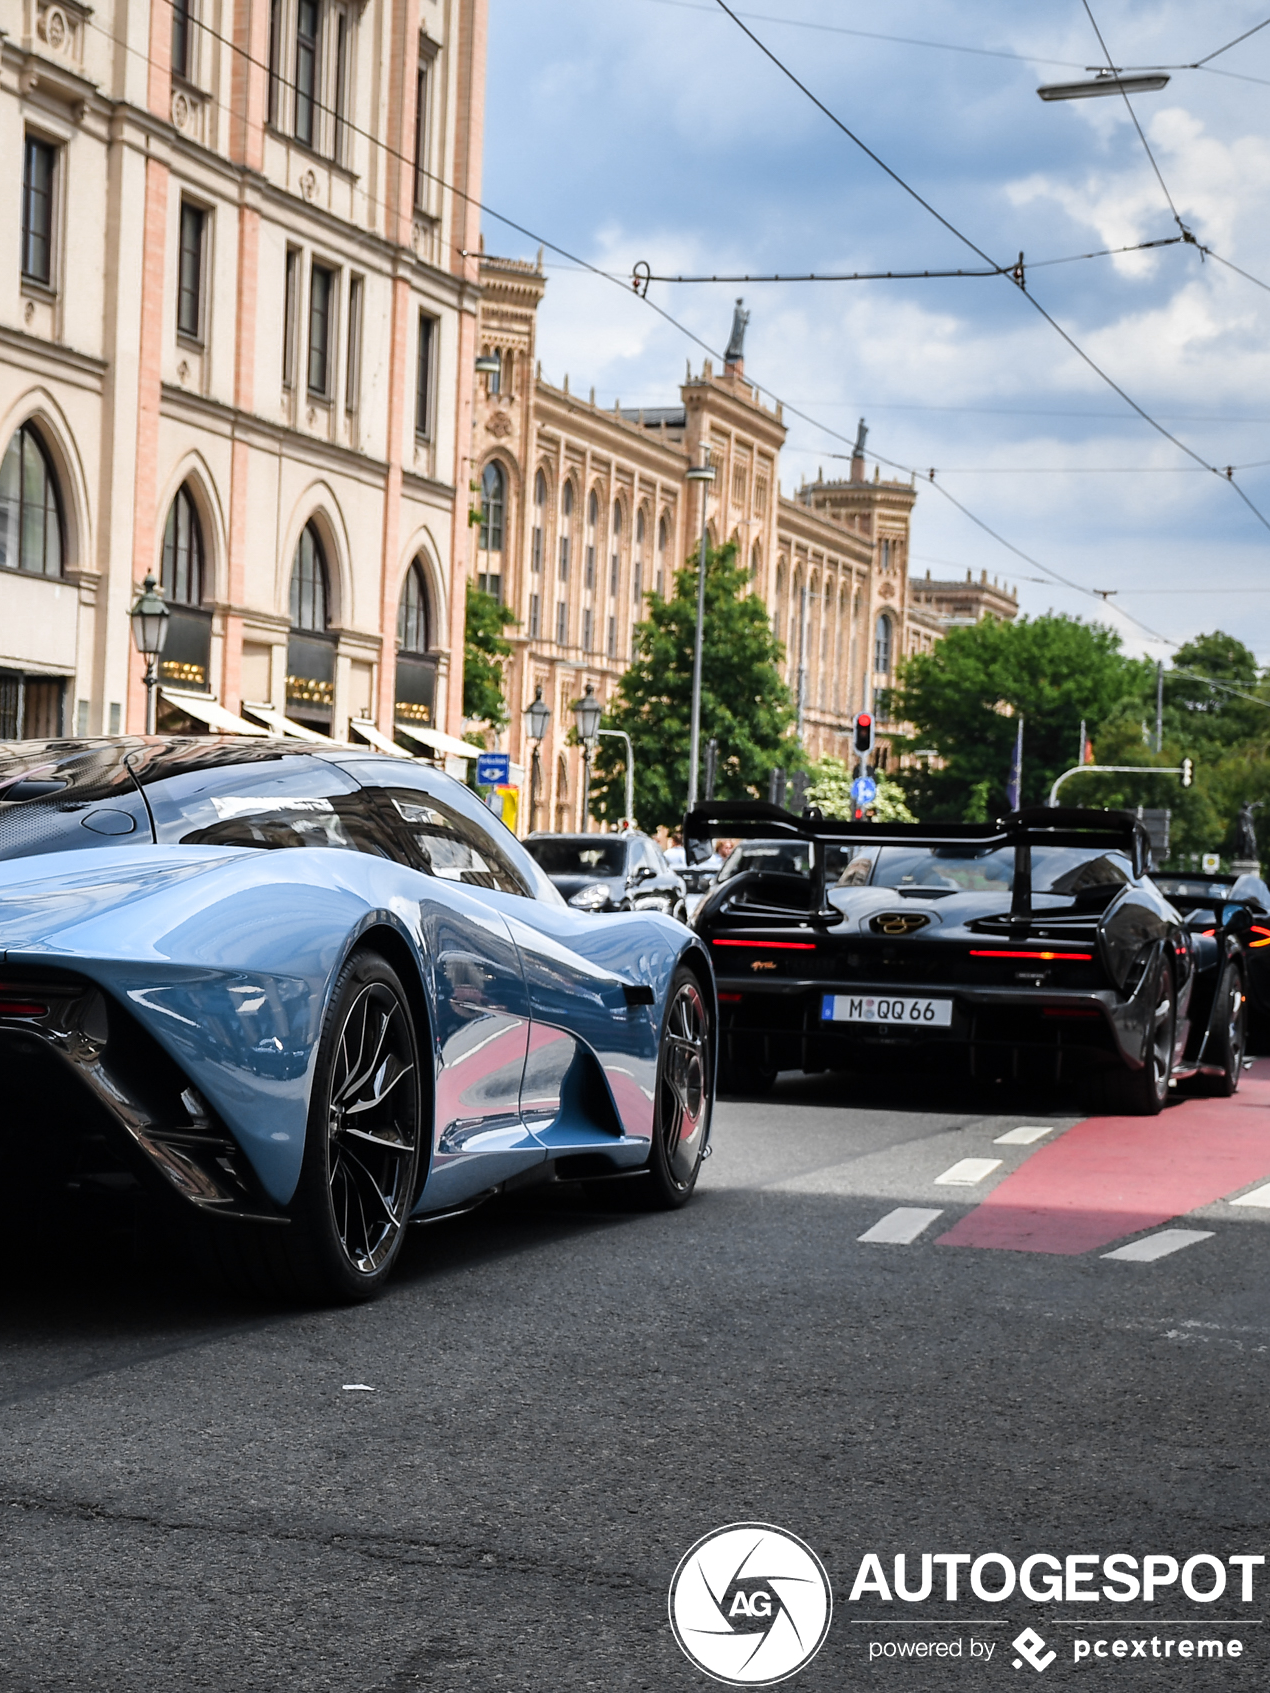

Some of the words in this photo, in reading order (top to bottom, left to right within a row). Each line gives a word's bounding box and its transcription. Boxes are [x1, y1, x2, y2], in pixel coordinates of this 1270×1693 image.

[848, 998, 863, 1018] M
[877, 1000, 905, 1020] QQ
[909, 1001, 935, 1021] 66
